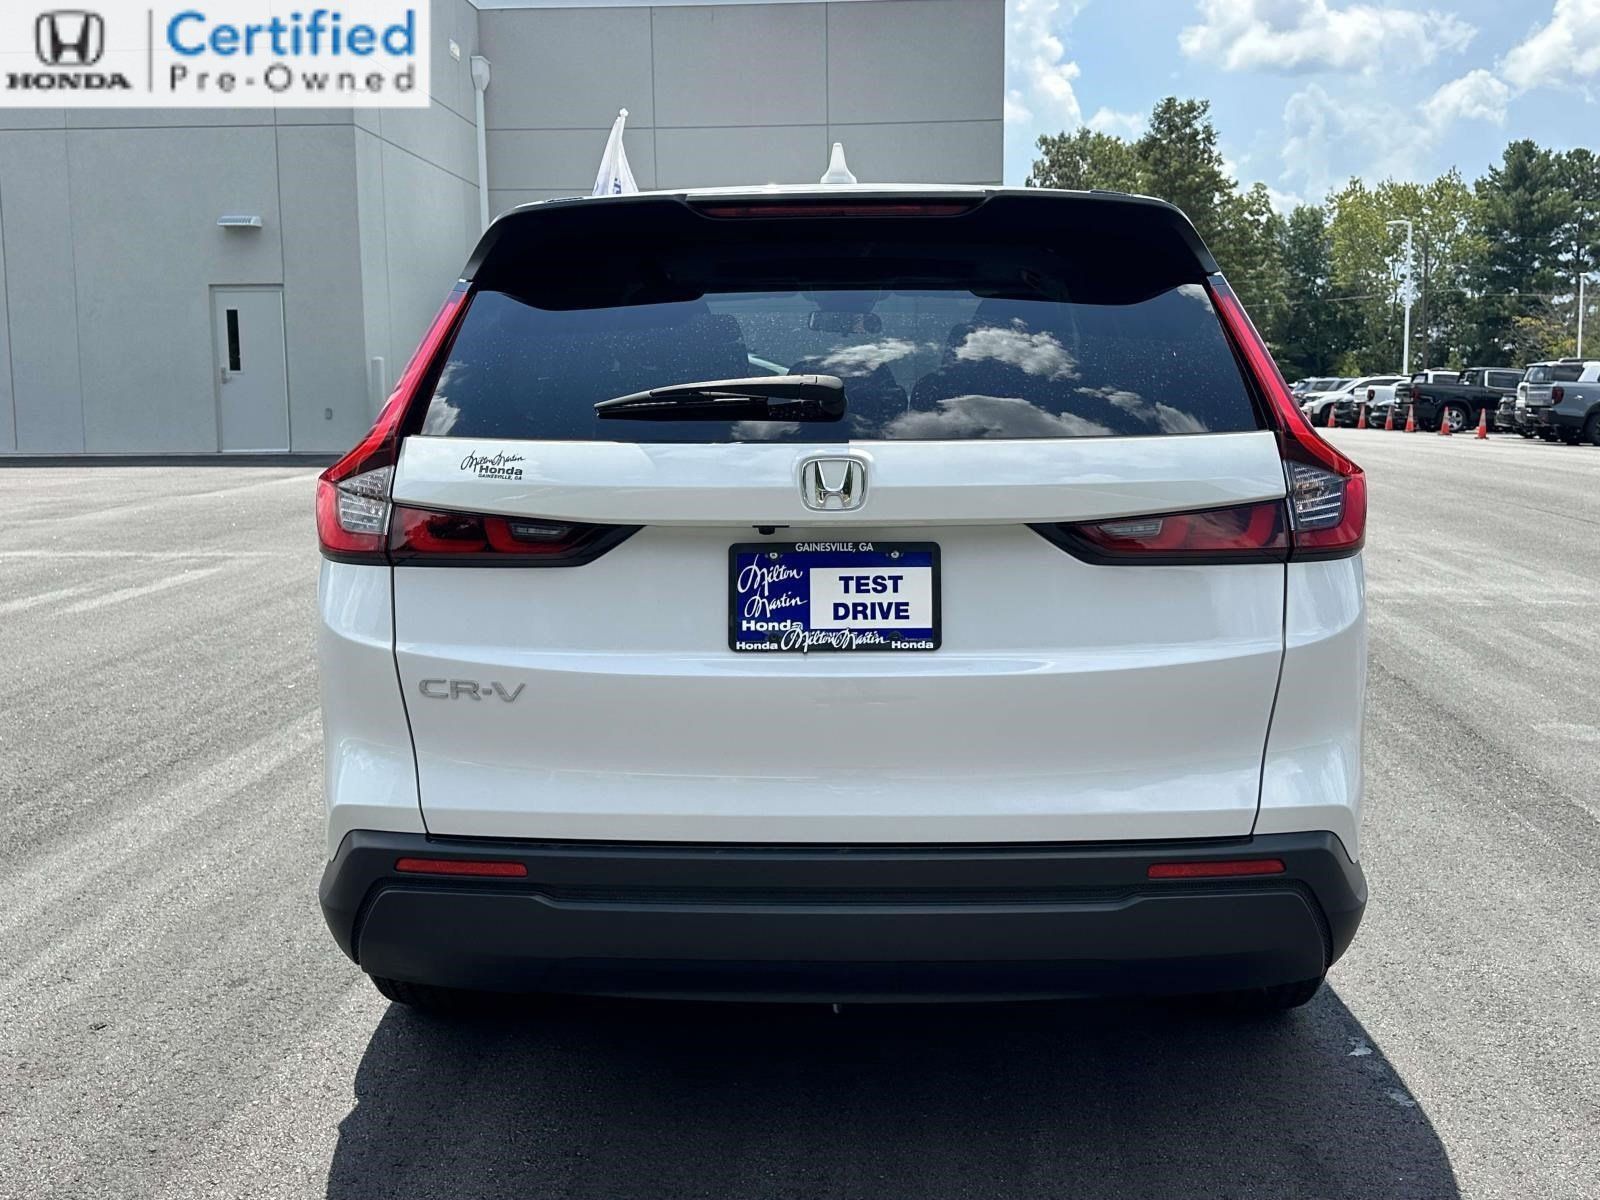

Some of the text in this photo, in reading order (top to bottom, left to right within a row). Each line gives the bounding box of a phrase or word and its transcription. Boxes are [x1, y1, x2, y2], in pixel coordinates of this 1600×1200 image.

[479, 465, 523, 476] Honda
[795, 543, 874, 552] GAINESVILLE, GA
[737, 554, 803, 596] Milton
[839, 575, 903, 594] TEST
[744, 588, 808, 618] Martin
[833, 602, 910, 620] DRIVE
[742, 619, 803, 631] Honda
[736, 628, 934, 652] Honda Milton Martin Honda
[419, 679, 526, 702] CR-V
